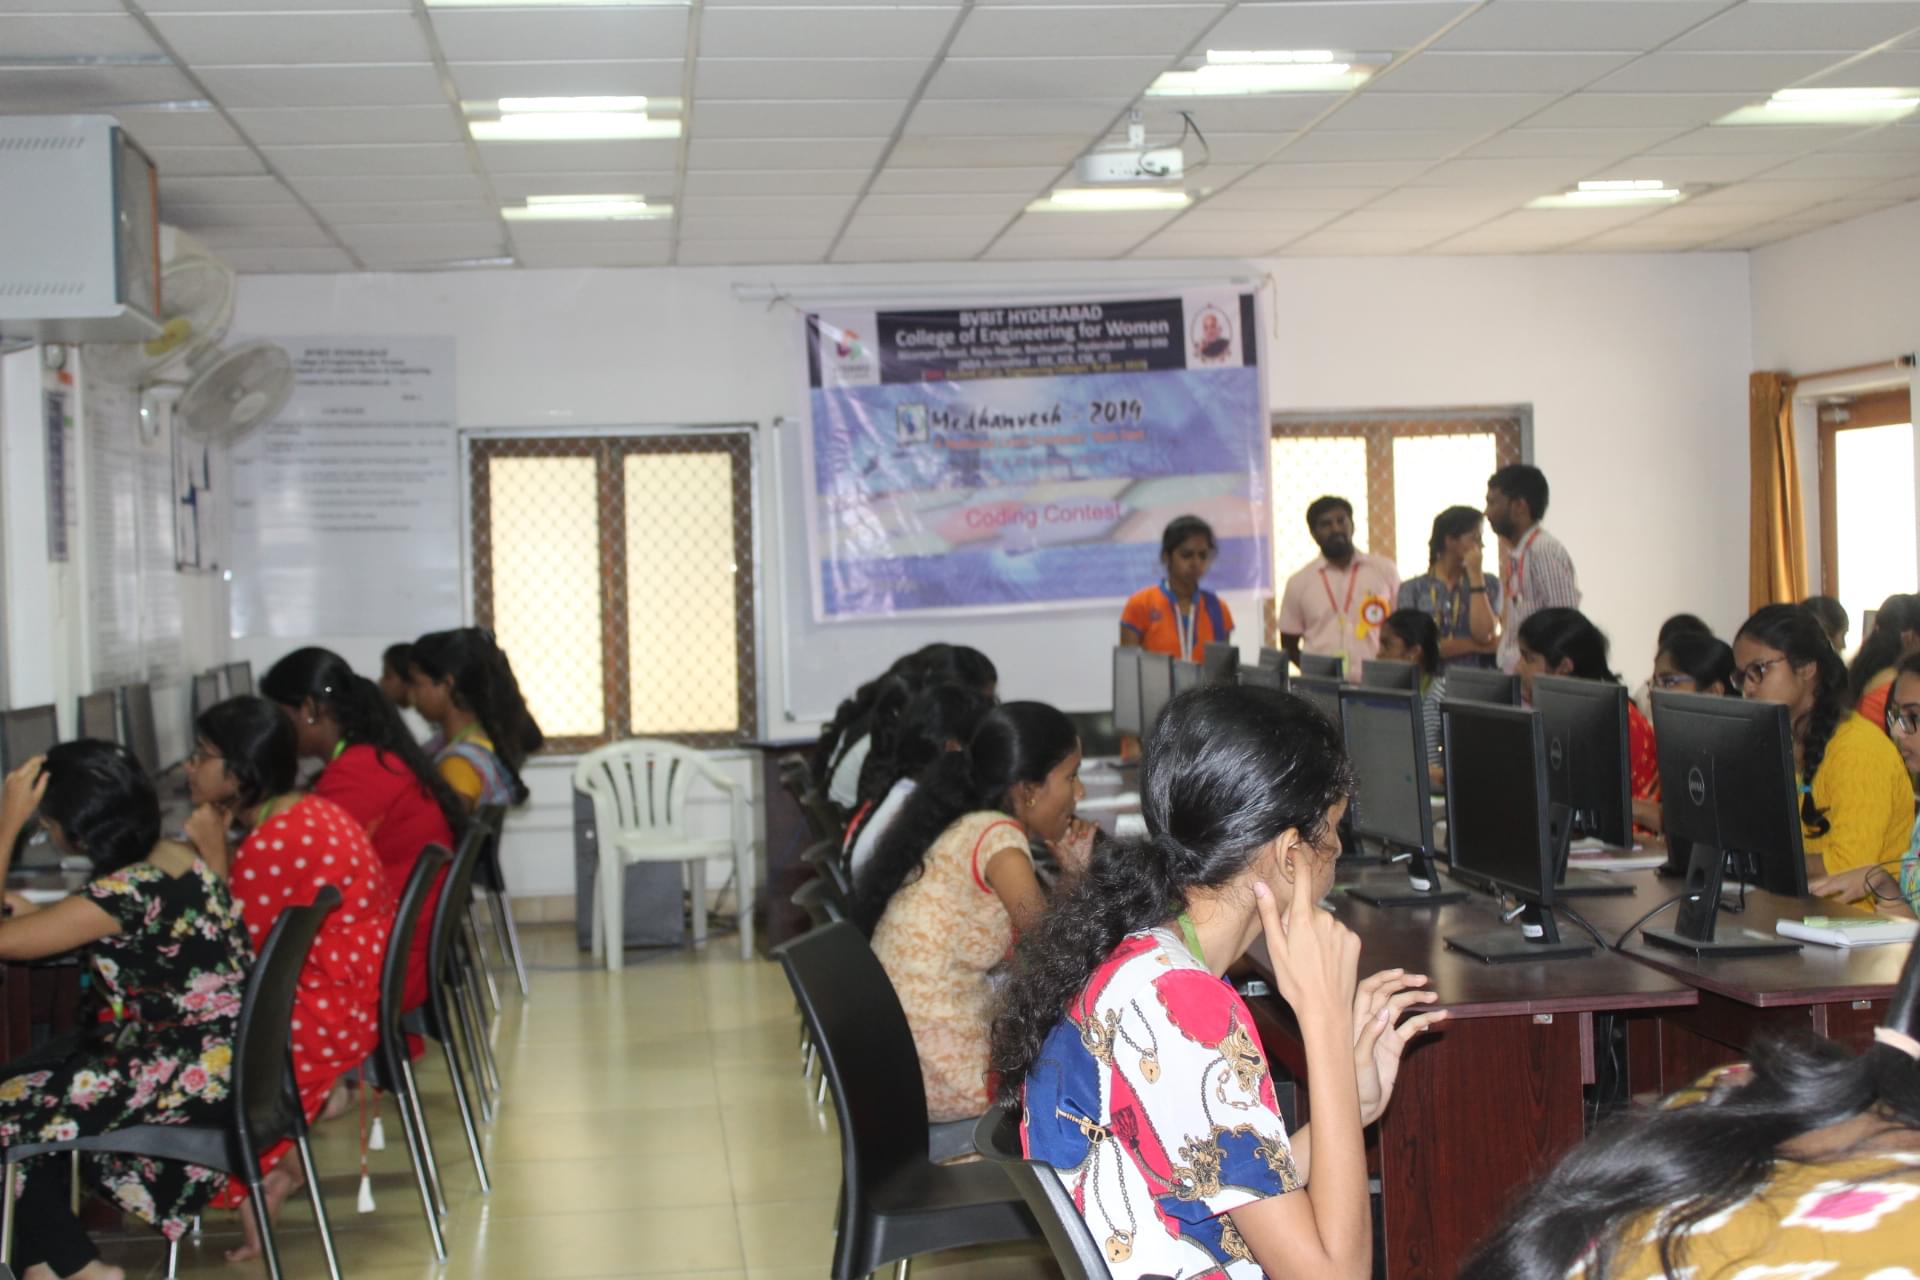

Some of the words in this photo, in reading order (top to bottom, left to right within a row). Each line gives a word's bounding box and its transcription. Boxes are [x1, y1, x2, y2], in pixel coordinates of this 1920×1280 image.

[960, 309, 1003, 327] BVRIT
[1007, 304, 1103, 326] HYDERABAD
[896, 329, 956, 348] College
[959, 326, 976, 344] of
[981, 322, 1076, 346] Engineering
[1078, 321, 1101, 338] for
[1105, 319, 1169, 336] Women
[1090, 399, 1142, 425] 2019
[965, 506, 1038, 529] Coding
[1044, 501, 1120, 522] Contest
